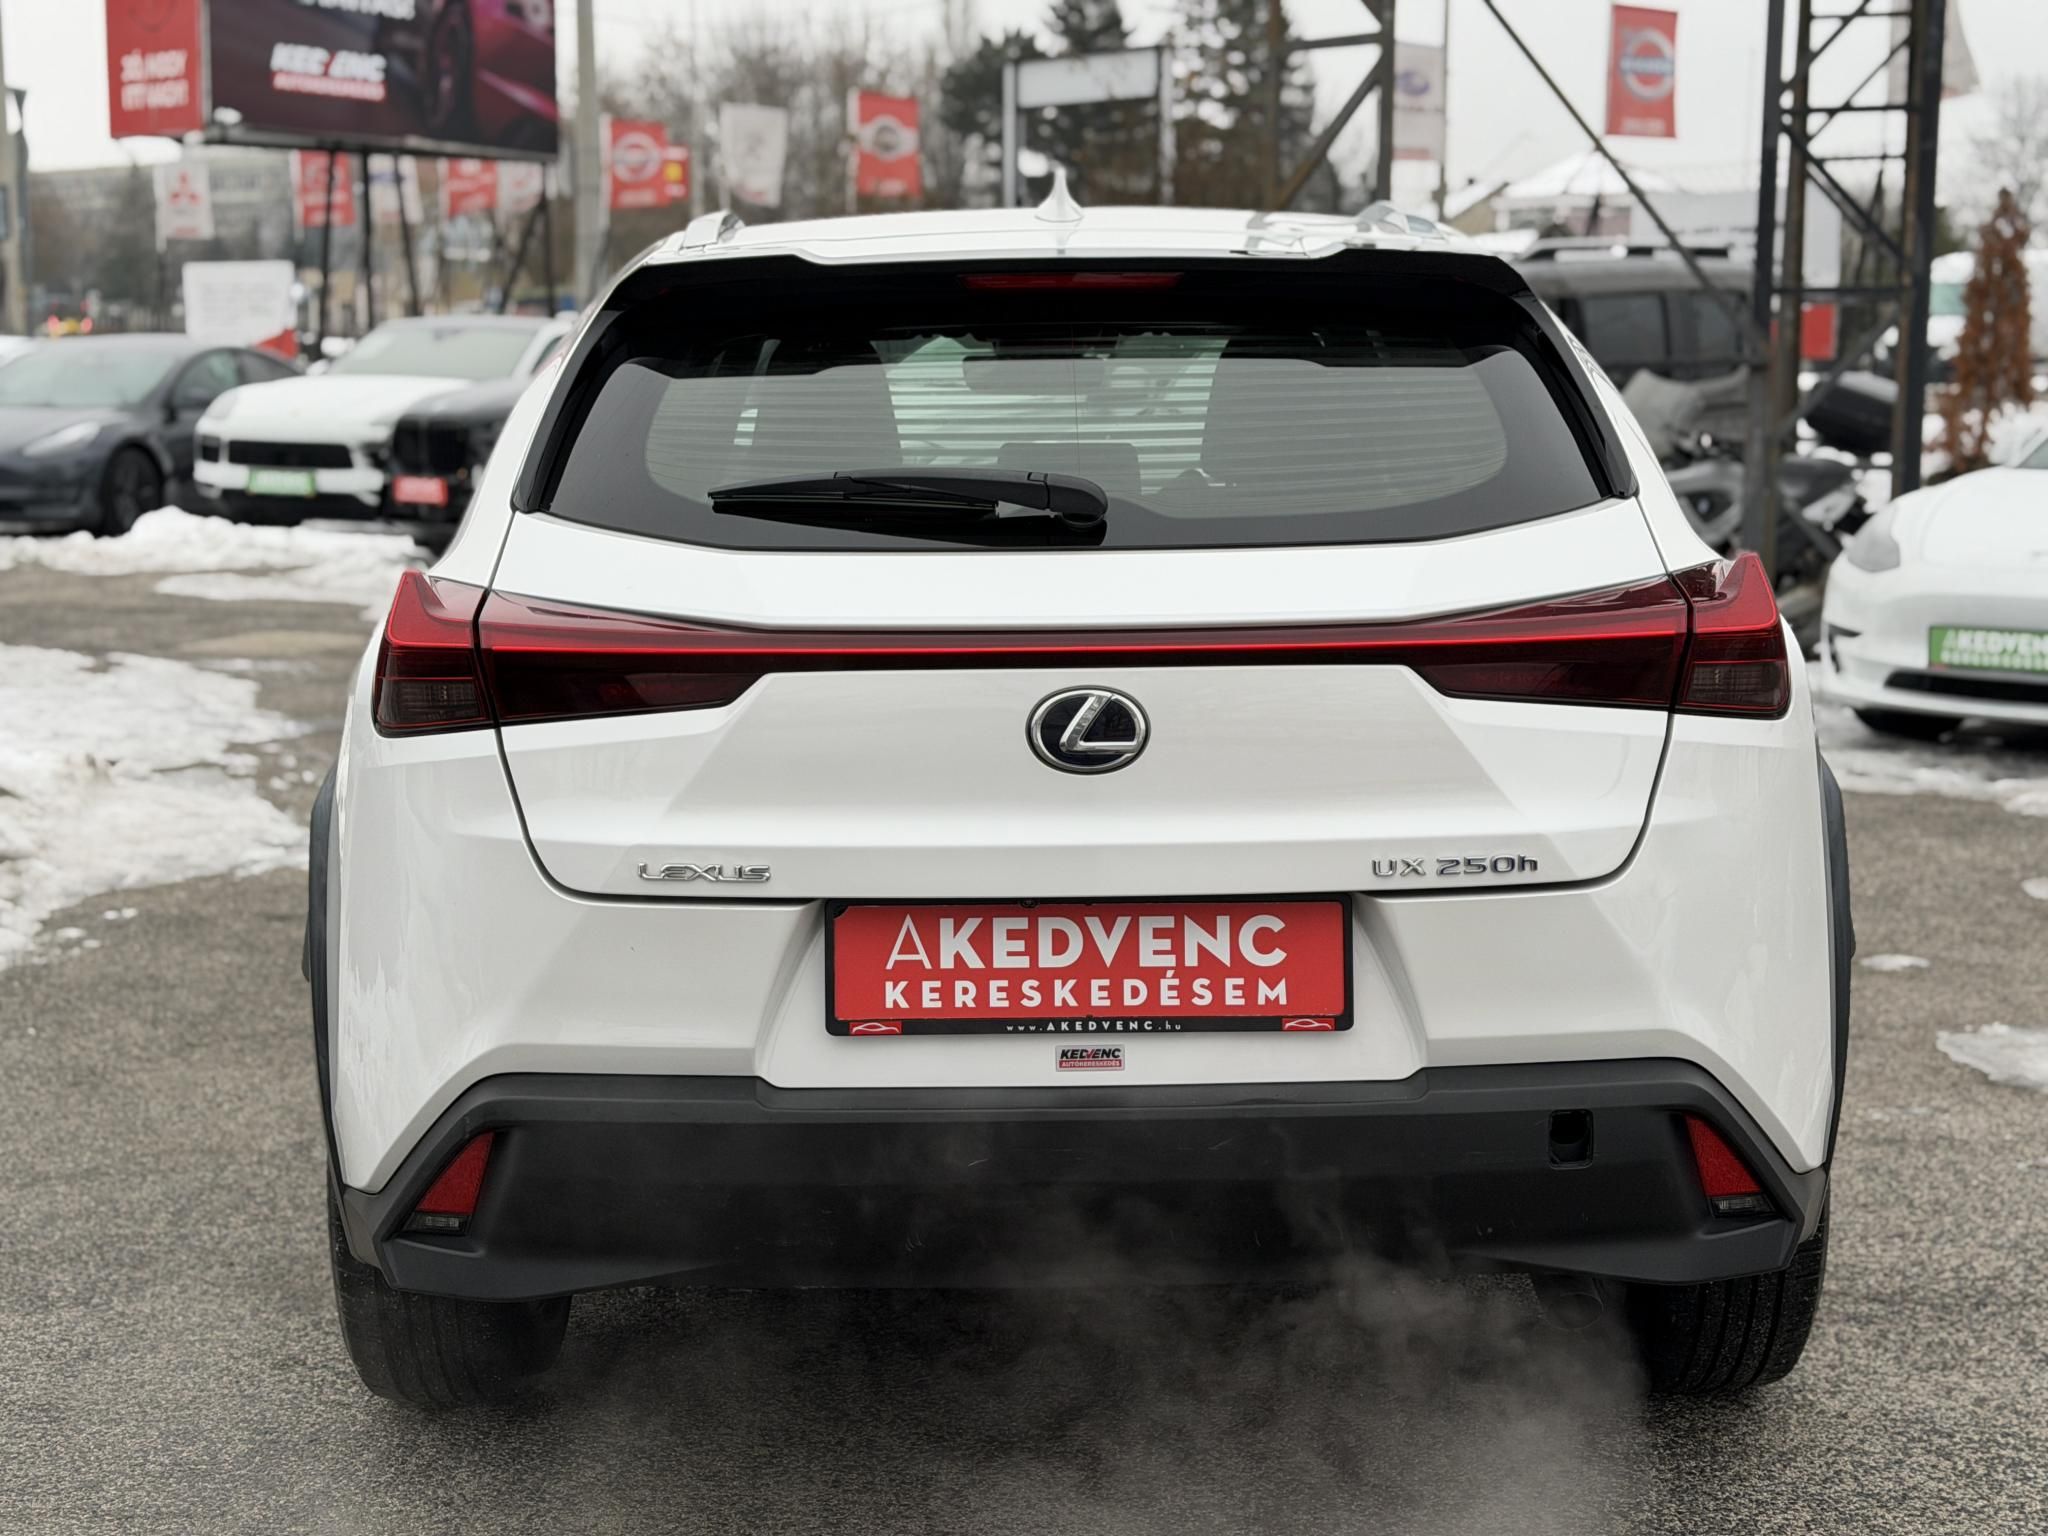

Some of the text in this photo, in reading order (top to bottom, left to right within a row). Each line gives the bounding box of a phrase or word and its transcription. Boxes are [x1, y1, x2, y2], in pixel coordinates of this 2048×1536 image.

[638, 862, 772, 883] LEXUS
[1372, 854, 1538, 877] UX 250h
[886, 914, 1288, 970] AKEDVENC
[885, 970, 1288, 1009] KERESKEDÉSEM
[1006, 1020, 1182, 1032] www.AKEDVENC.hu
[1060, 1047, 1122, 1060] KEDVENC
